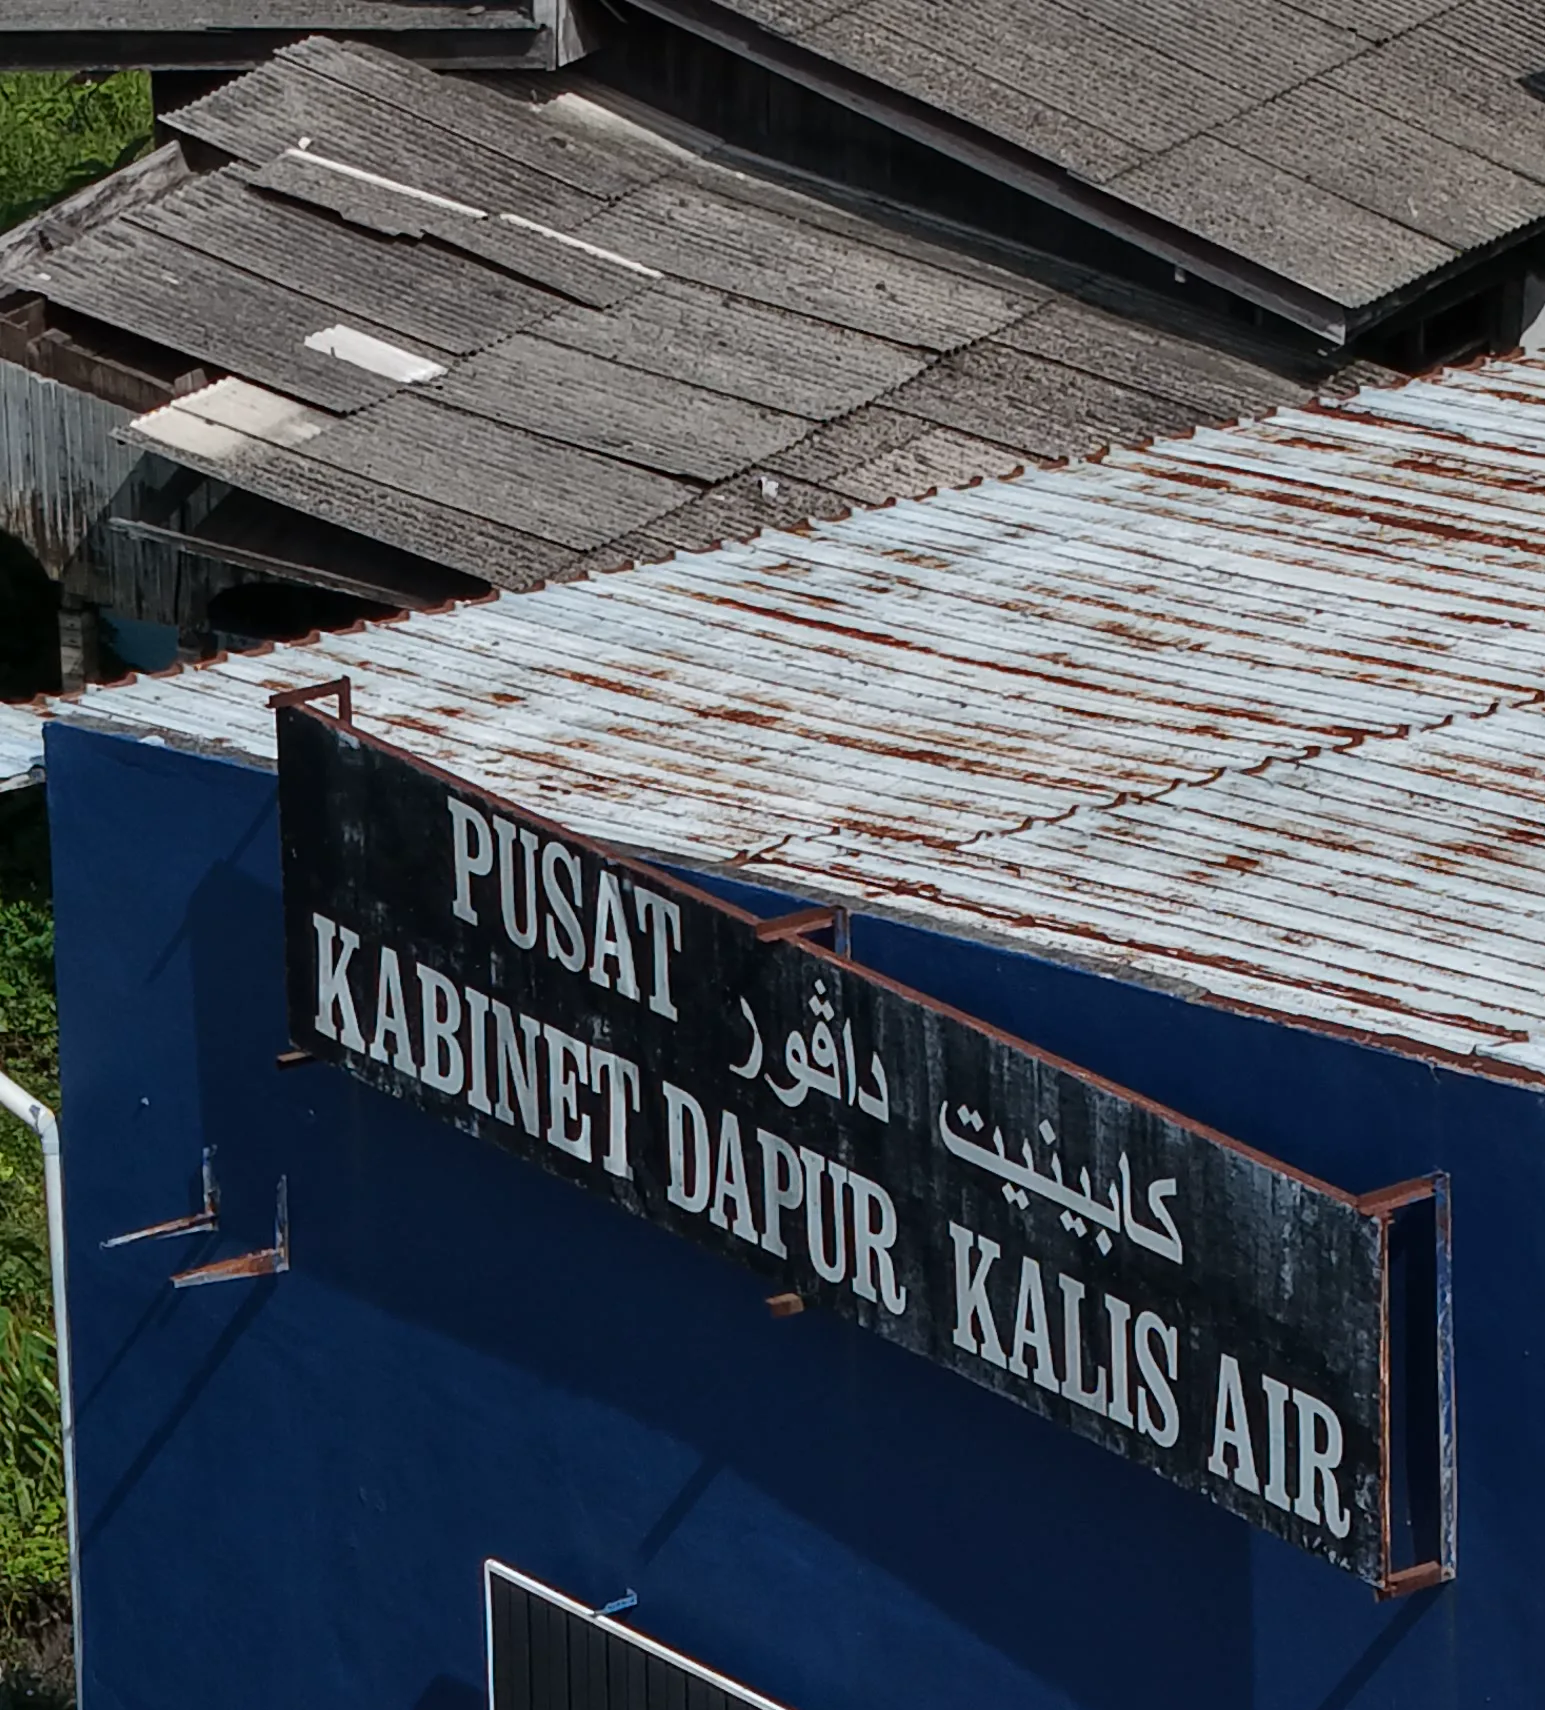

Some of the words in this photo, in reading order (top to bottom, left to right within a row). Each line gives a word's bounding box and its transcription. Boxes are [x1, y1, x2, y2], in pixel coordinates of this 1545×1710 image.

[448, 795, 682, 1022] PUSAT
[313, 912, 640, 1181] KABINET
[663, 1081, 906, 1316] DAPUR
[949, 1221, 1180, 1449] KALIS
[1208, 1353, 1350, 1538] AIR
